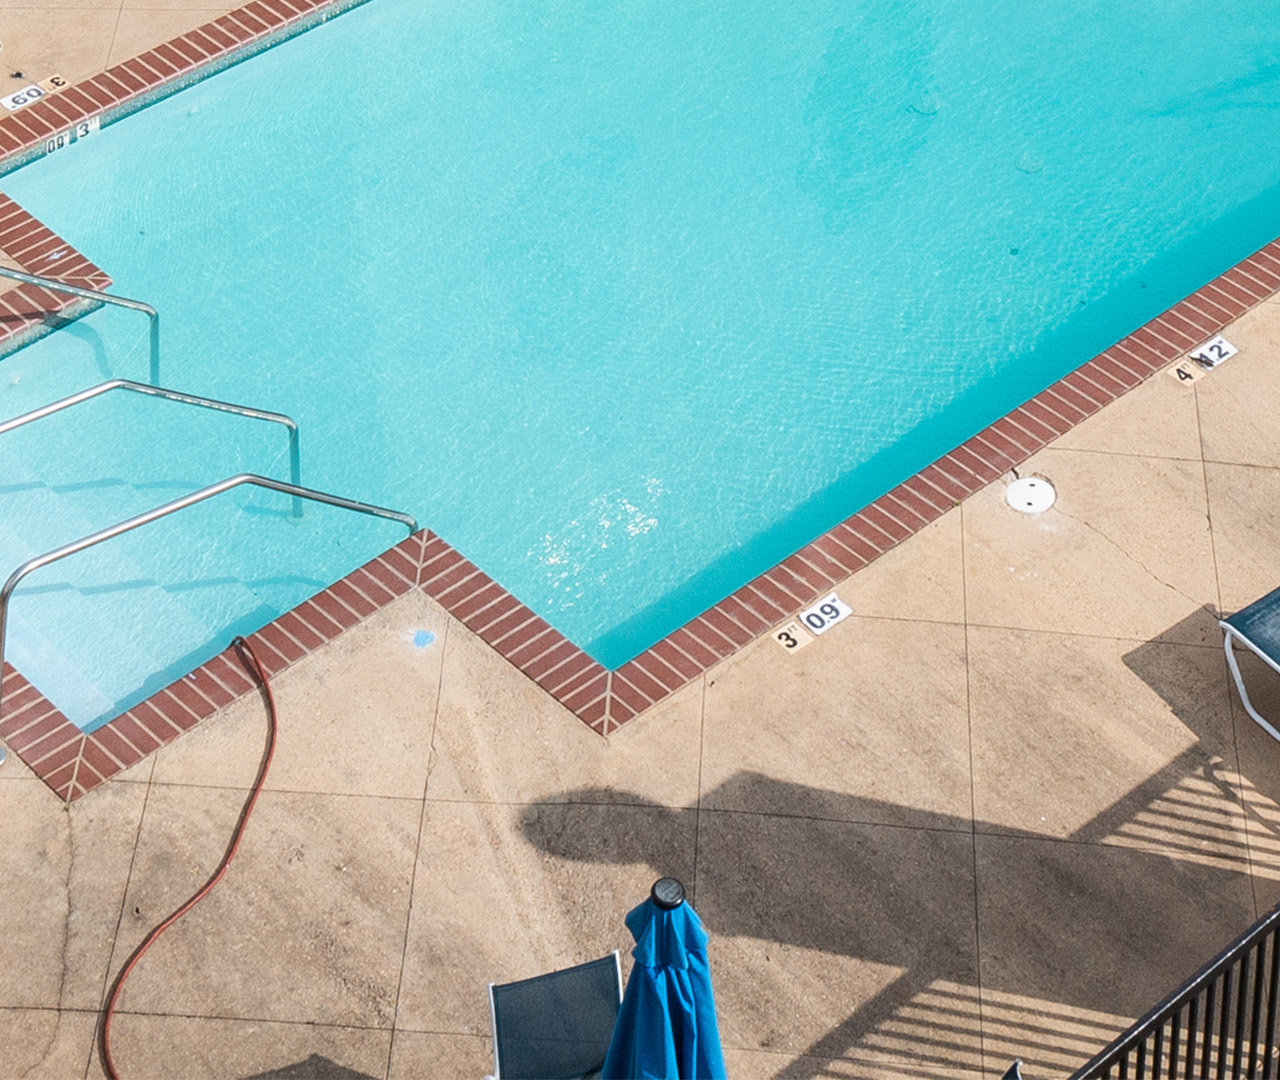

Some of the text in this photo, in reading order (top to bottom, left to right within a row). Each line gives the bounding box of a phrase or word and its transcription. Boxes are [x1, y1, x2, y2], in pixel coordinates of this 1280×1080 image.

[50, 76, 67, 88] 3
[1176, 368, 1193, 381] 4
[778, 631, 798, 649] 3
